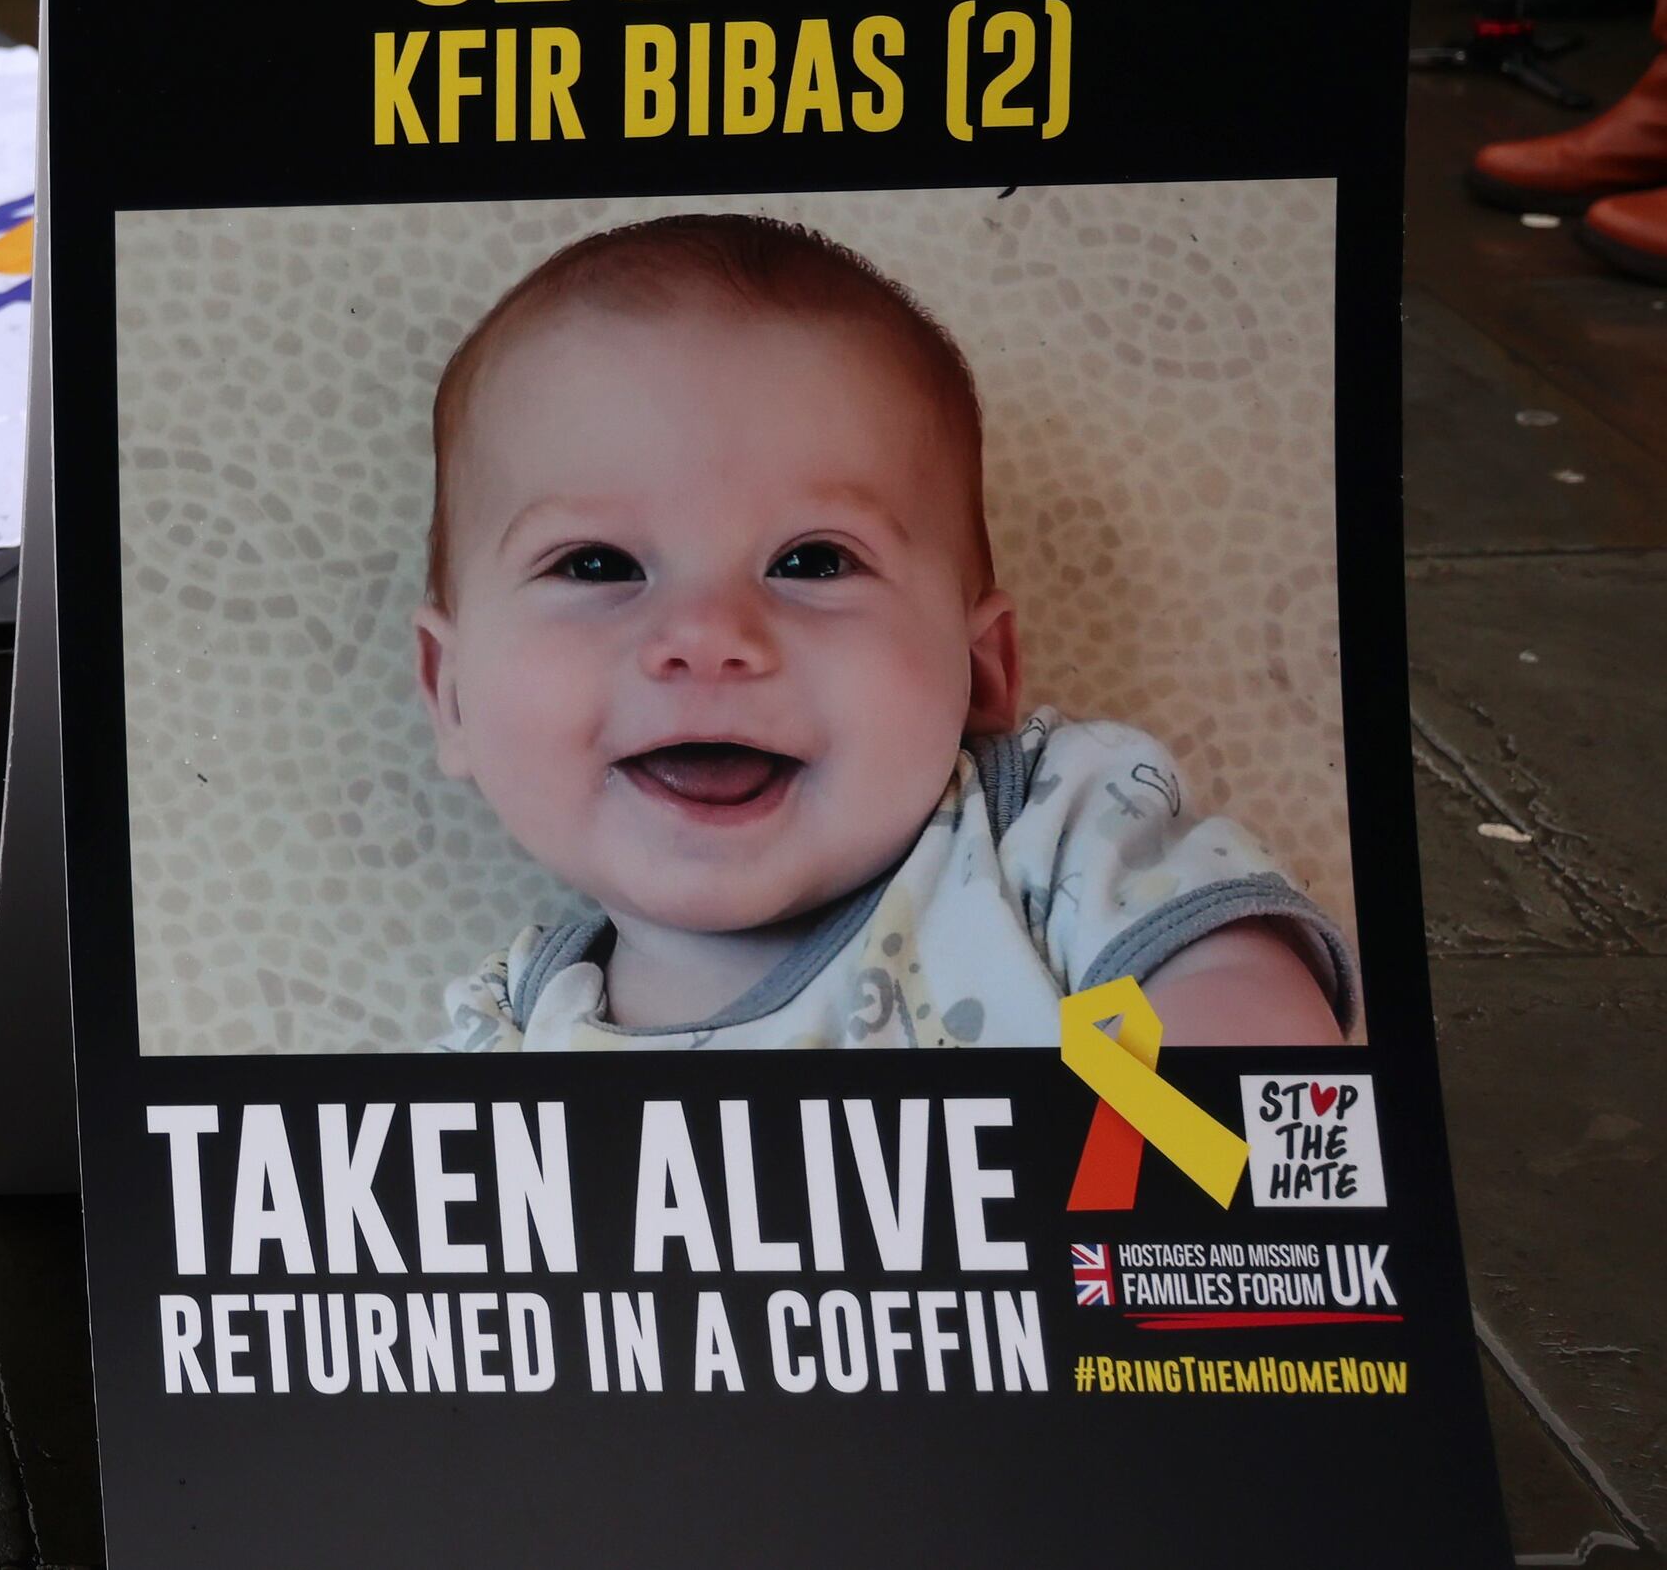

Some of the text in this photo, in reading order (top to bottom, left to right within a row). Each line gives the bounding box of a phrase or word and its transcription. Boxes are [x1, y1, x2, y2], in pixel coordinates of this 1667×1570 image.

[374, 26, 586, 145] KFIR
[624, 15, 905, 138] BIBAS
[1275, 1121, 1348, 1161] THE
[146, 1097, 1029, 1276] TAKEN ALIVE
[1269, 1161, 1358, 1201] HATE
[1118, 1244, 1320, 1267] HOSTAGES AND MISSING
[1325, 1244, 1398, 1306] UK
[1122, 1273, 1326, 1306] FAMILIES FORUM
[159, 1289, 1049, 1395] RETURNED IN A COFFIN
